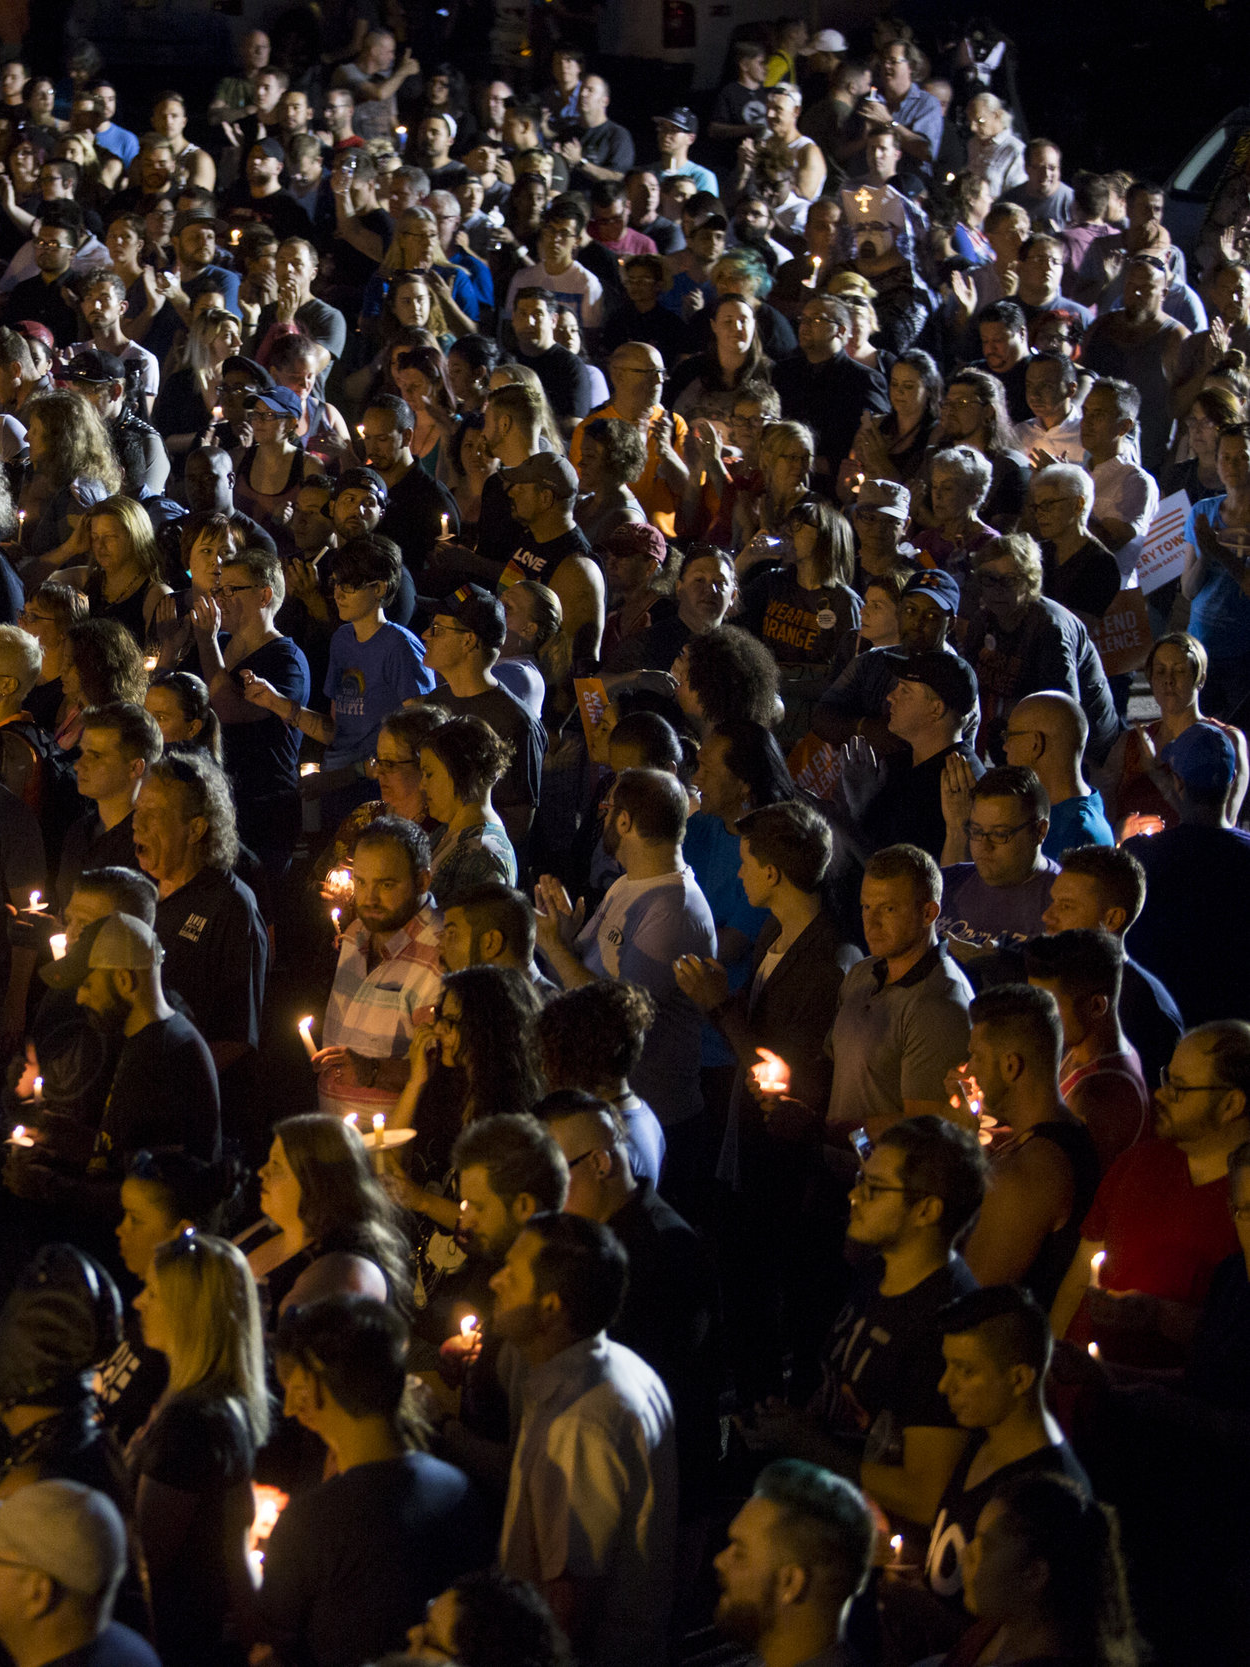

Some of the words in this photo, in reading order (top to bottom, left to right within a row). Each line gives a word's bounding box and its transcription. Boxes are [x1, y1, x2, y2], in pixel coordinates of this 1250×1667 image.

[513, 547, 547, 573] LOVE
[766, 600, 803, 626] WEAR
[1103, 611, 1137, 634] END
[583, 691, 598, 724] GUN
